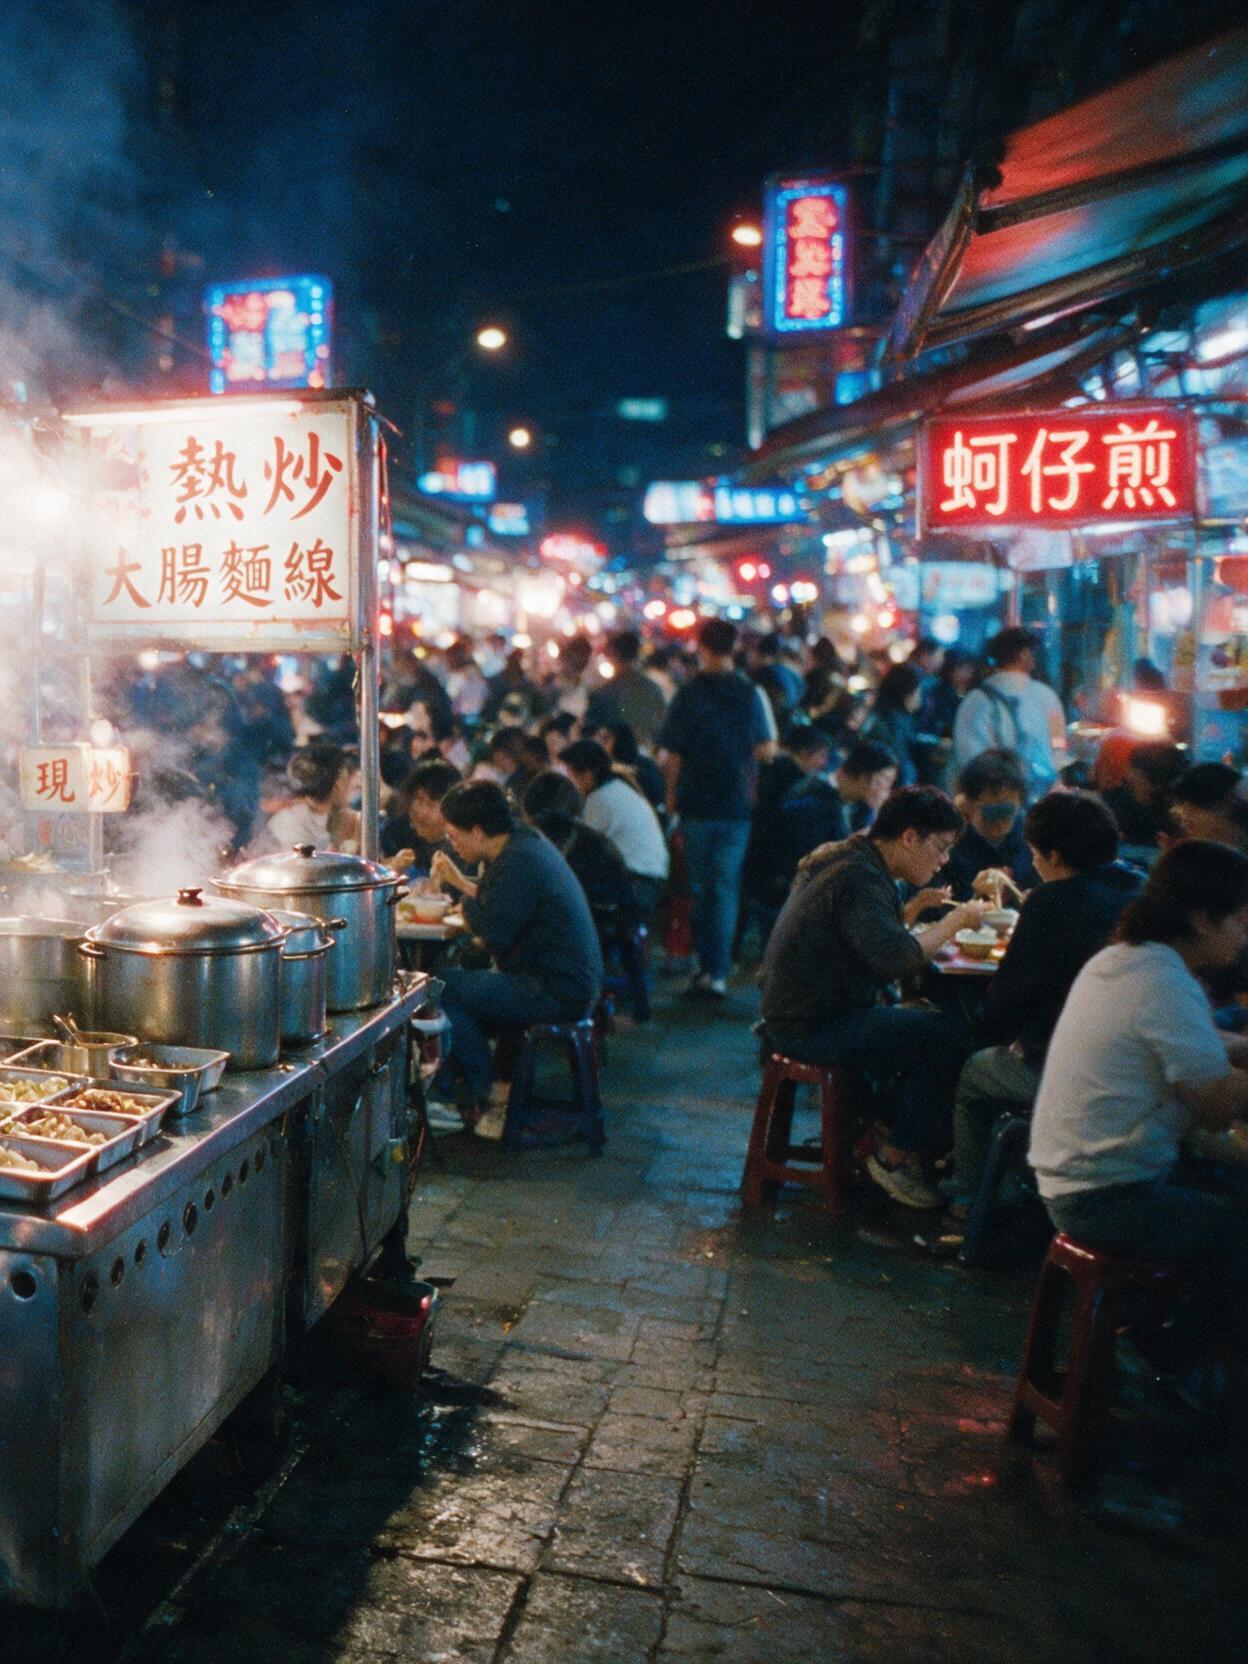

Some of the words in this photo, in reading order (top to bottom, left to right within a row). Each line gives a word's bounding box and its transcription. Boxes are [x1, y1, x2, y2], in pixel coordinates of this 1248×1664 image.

[169, 431, 343, 524] 熱炒
[940, 420, 1177, 515] 蚵仔煎
[102, 538, 343, 608] 大腸麵線
